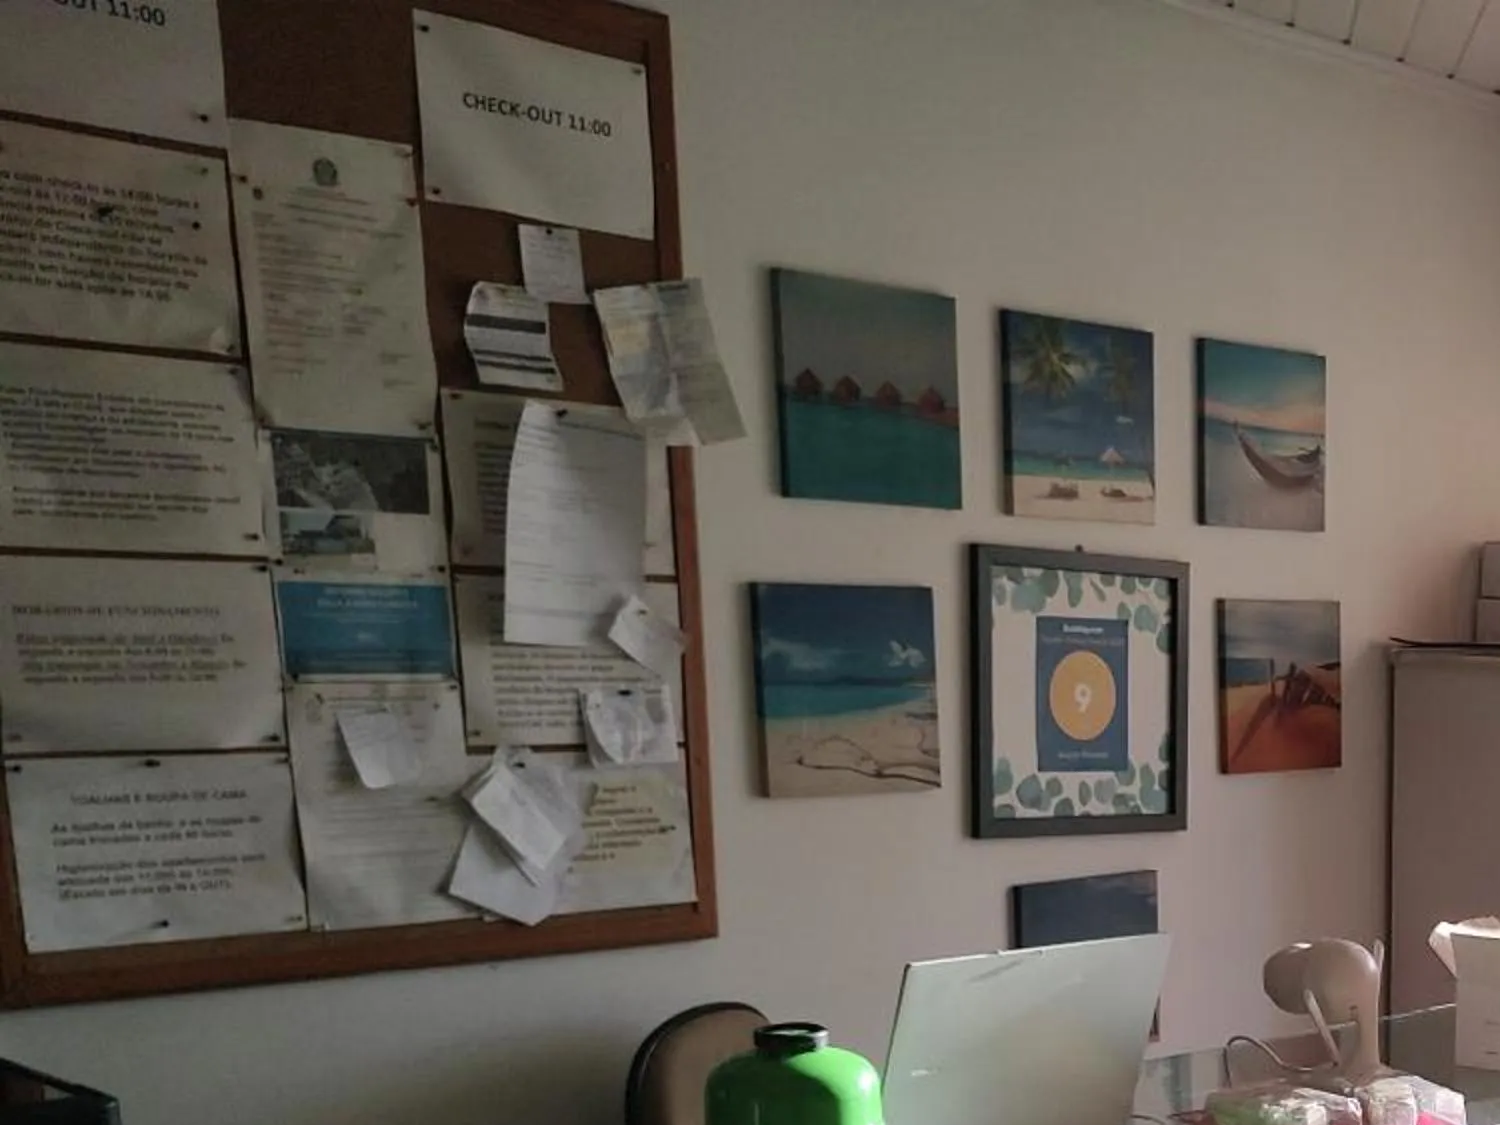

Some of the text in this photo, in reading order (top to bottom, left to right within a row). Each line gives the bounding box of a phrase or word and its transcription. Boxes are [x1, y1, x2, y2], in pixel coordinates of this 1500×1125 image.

[106, 0, 166, 26] 11:00
[462, 92, 611, 137] CHECK-OUT 11:00
[1073, 682, 1093, 714] 9
